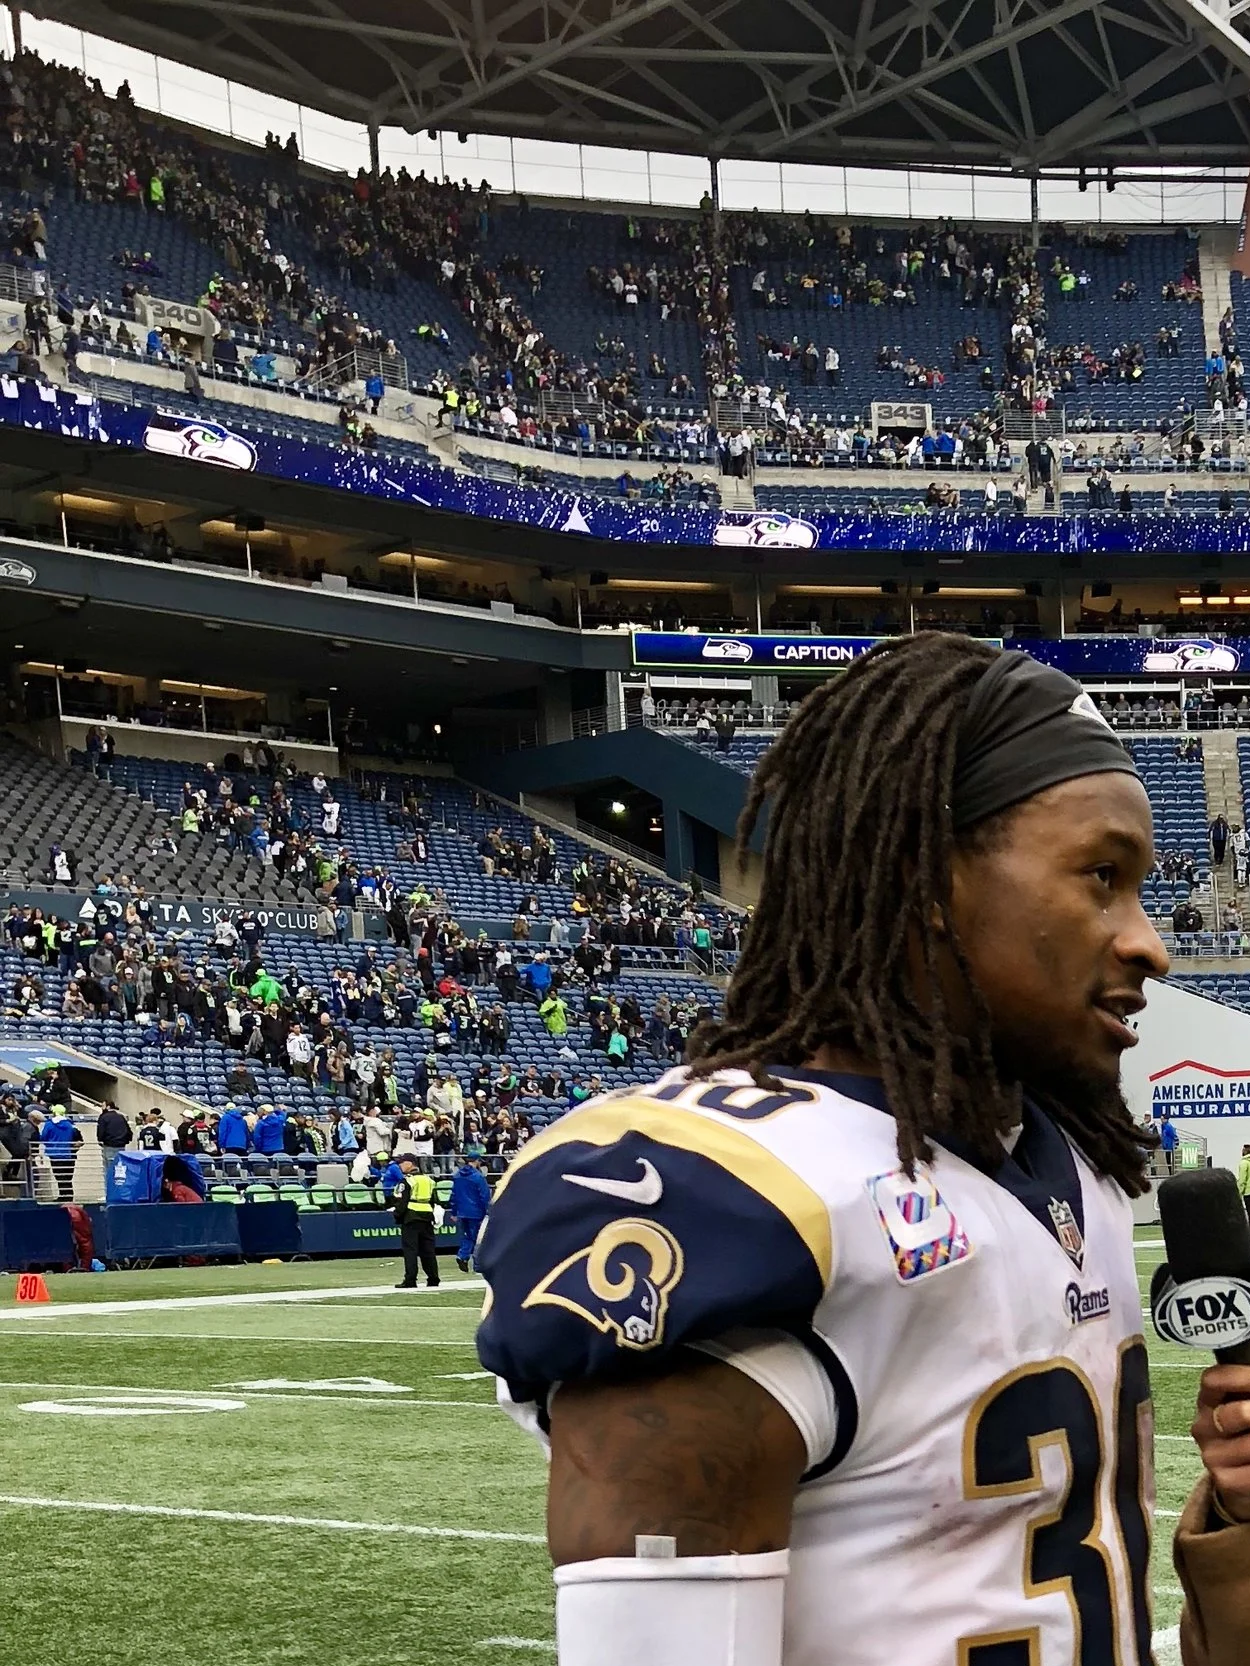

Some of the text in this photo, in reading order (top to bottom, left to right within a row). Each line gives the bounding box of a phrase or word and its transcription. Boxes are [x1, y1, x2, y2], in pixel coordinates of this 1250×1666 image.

[147, 300, 202, 326] 340
[878, 405, 926, 420] 343
[640, 519, 660, 532] 20
[774, 645, 853, 660] CAPTION
[103, 899, 192, 923] DTA
[275, 912, 318, 930] CLUB
[1153, 1084, 1224, 1100] AMERICAN
[144, 1134, 155, 1147] 12
[1181, 1147, 1199, 1167] NW
[20, 1275, 38, 1300] 30
[1065, 1282, 1110, 1324] Rams
[1175, 1289, 1244, 1326] FOX
[1182, 1317, 1249, 1338] SPORTS
